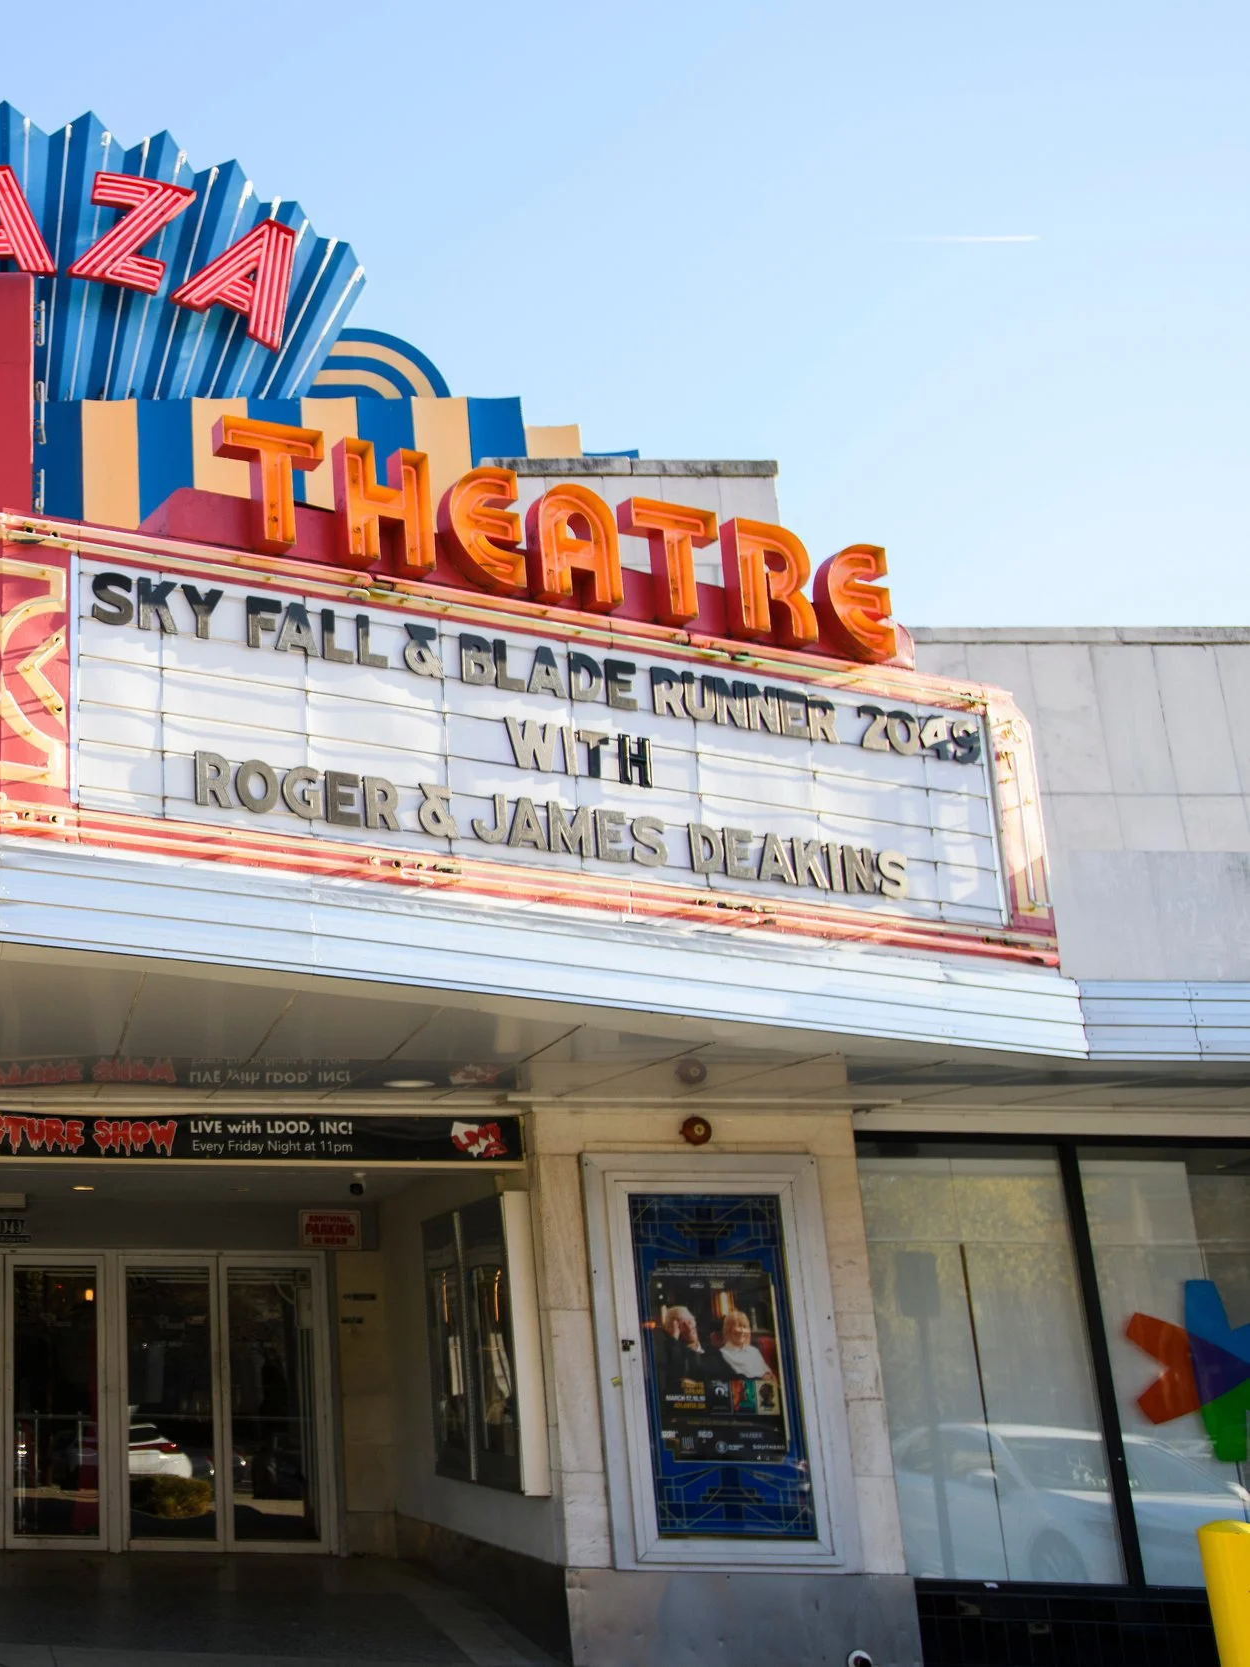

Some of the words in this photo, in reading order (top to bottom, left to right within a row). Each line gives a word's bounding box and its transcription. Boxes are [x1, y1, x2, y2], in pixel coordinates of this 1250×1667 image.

[212, 414, 897, 663] THEATRE
[90, 571, 224, 640] SKY
[245, 595, 390, 669] FALL
[401, 623, 445, 680] &
[459, 632, 640, 712] BLADE
[651, 666, 839, 746] RUNNER
[856, 704, 982, 765] 2049
[503, 715, 654, 790] WITH
[193, 750, 402, 833] ROGER
[417, 782, 461, 841] &
[470, 792, 668, 868] JAMES
[688, 820, 909, 901] DEAKINS
[92, 1118, 178, 1157] SHOW
[190, 1120, 222, 1134] LIVE
[227, 1120, 261, 1135] with
[266, 1121, 315, 1135] LDOD,
[319, 1121, 353, 1135] INC!
[192, 1139, 225, 1154] Every
[228, 1139, 264, 1154] Friday
[267, 1140, 301, 1155] Night
[304, 1141, 316, 1152] at
[320, 1140, 353, 1155] 11pm
[305, 1223, 356, 1235] PARKING
[308, 1214, 351, 1223] ADDITIONAL
